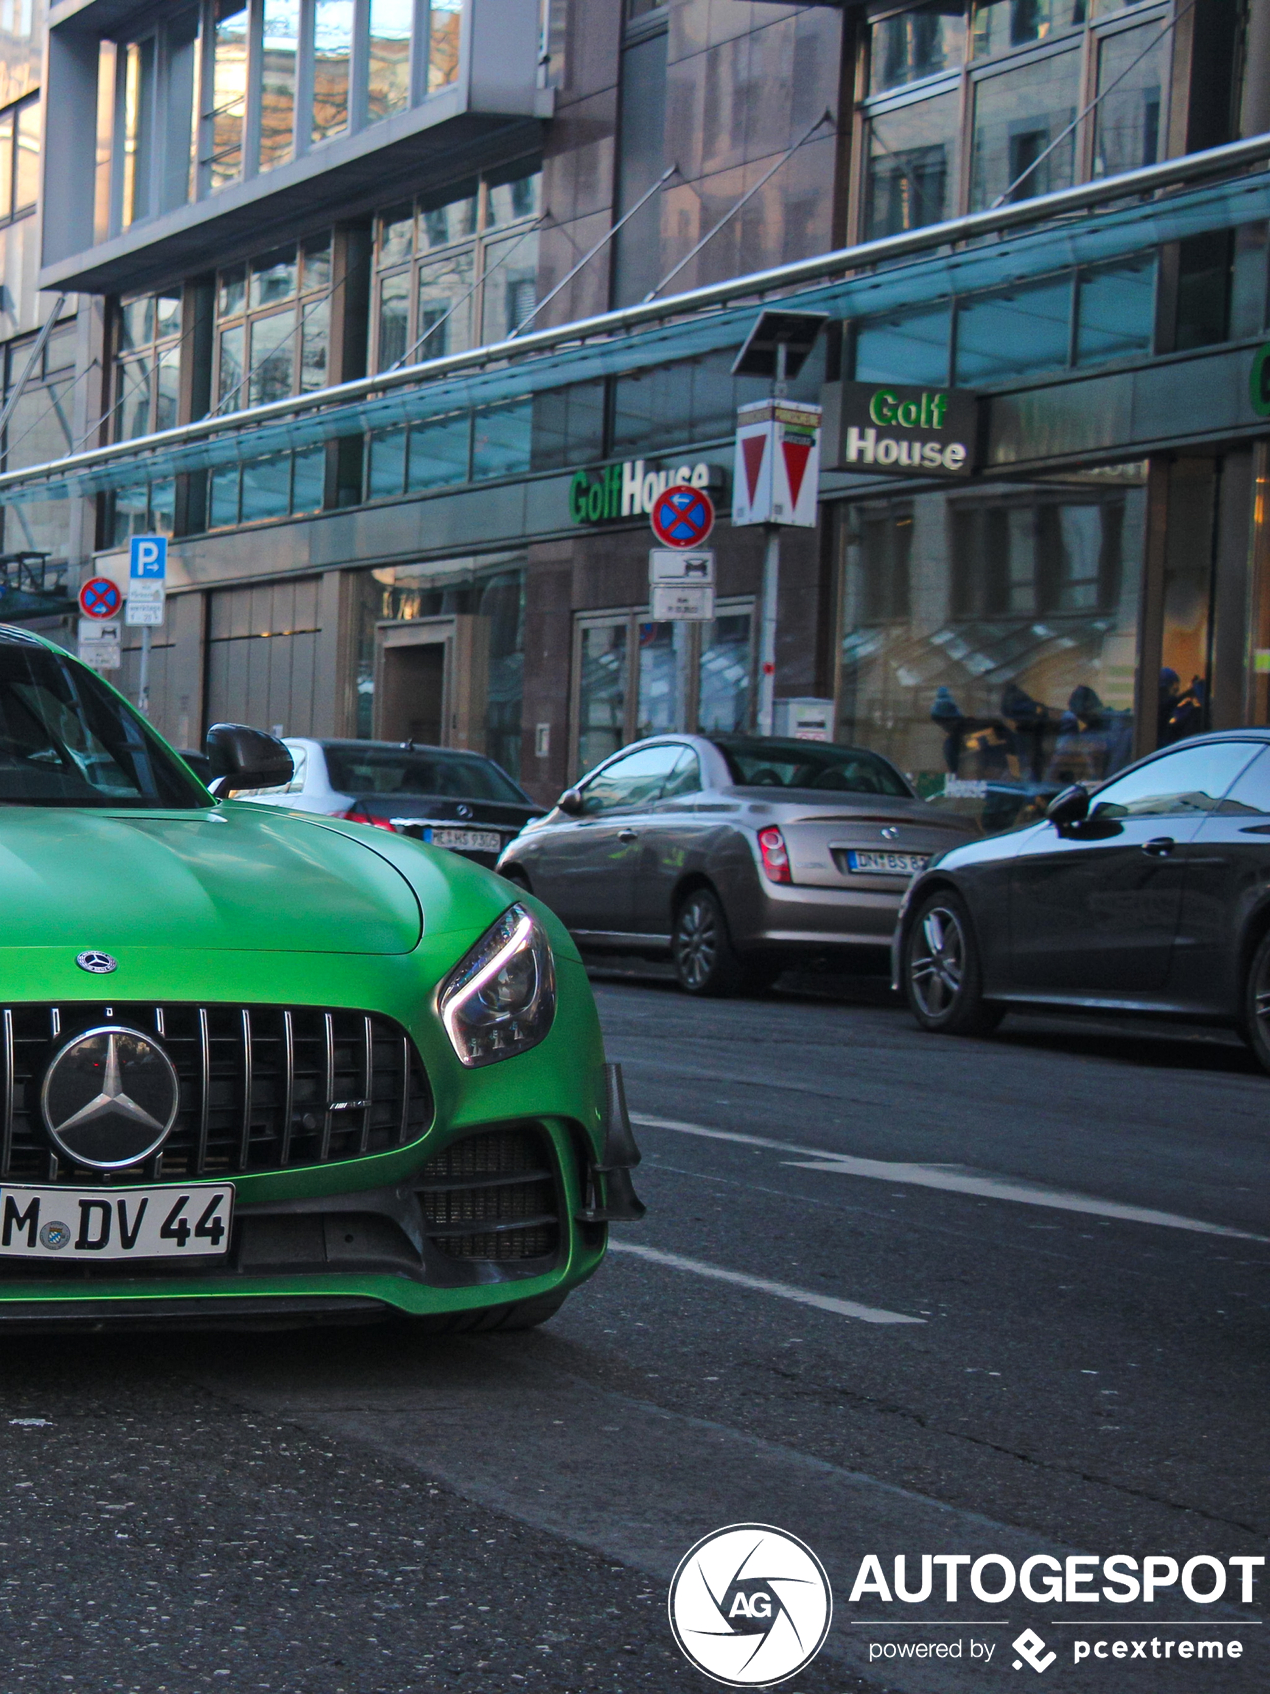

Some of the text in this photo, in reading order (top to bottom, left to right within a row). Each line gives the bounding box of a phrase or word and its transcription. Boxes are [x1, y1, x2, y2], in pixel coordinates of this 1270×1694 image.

[869, 389, 948, 429] Golf
[846, 426, 966, 470] House
[138, 541, 159, 576] P
[2, 1195, 41, 1247] M
[74, 1197, 149, 1250] DV
[160, 1193, 225, 1247] 44
